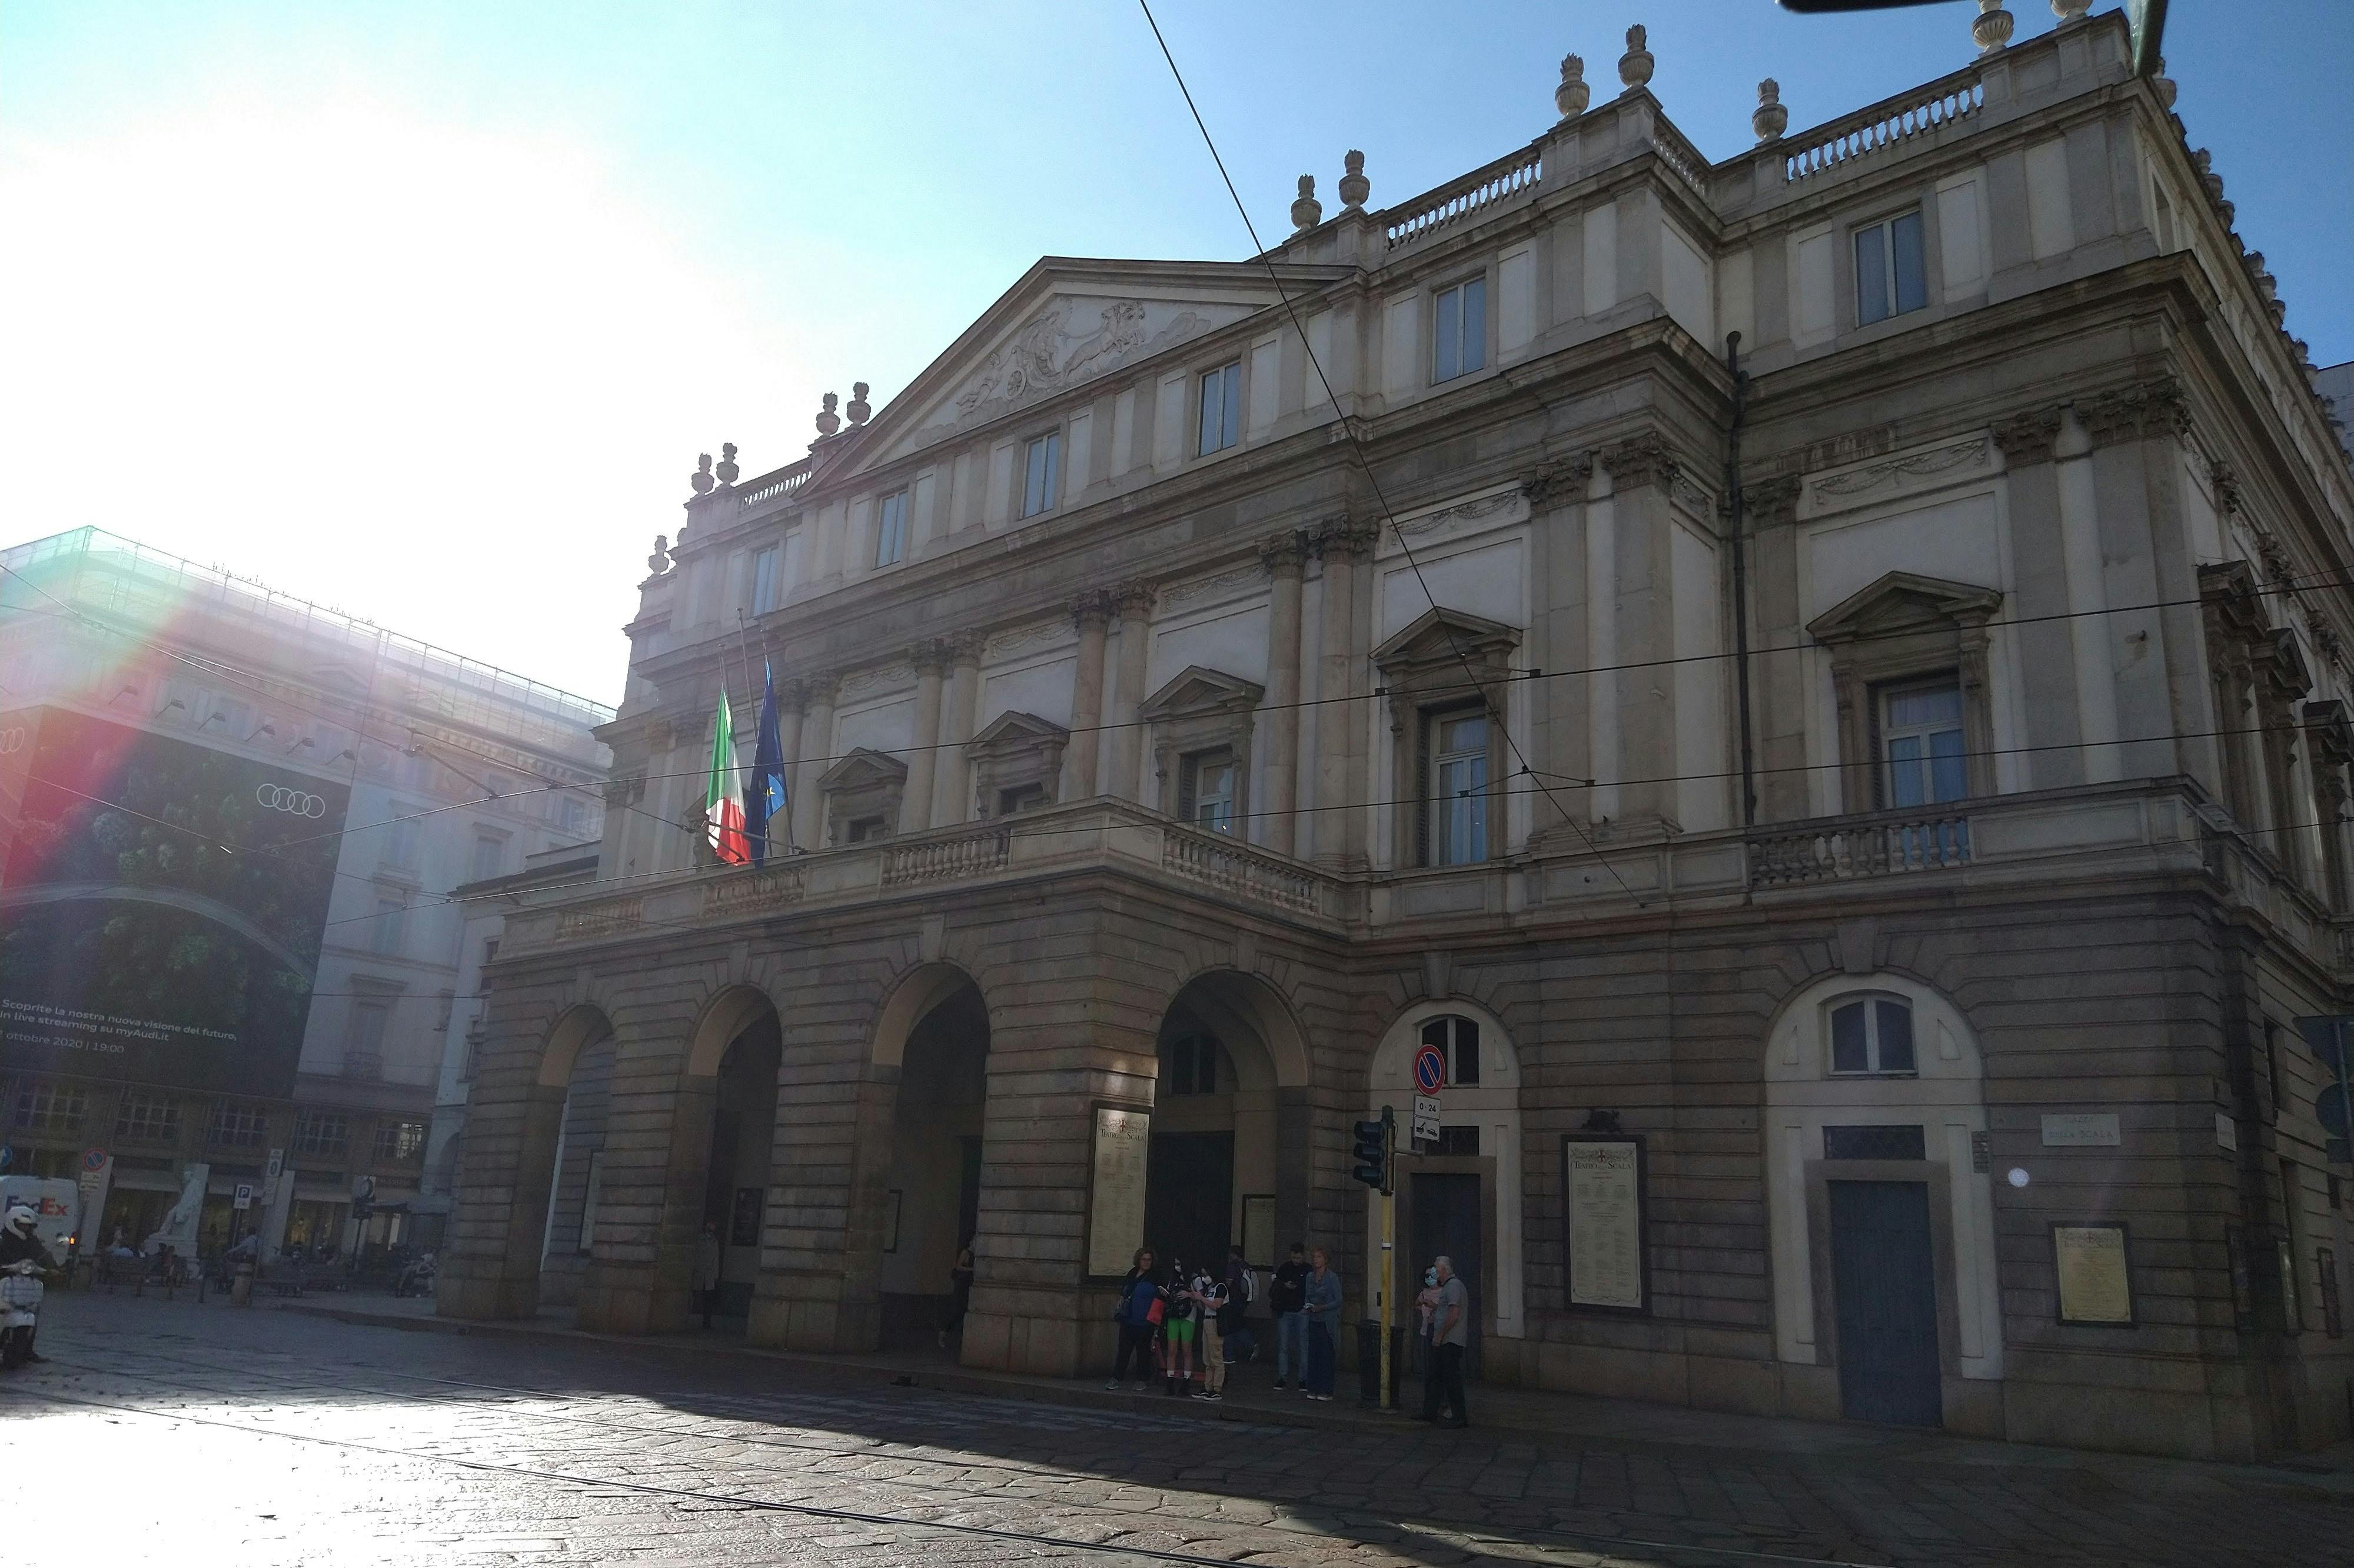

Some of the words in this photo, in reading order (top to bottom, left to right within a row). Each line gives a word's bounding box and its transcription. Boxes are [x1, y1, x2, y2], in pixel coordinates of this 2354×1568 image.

[2, 998, 52, 1013] Scoprite
[55, 1007, 65, 1016] la
[69, 1010, 105, 1021] nostra
[108, 1016, 141, 1026] nuova
[144, 1020, 181, 1032] visione
[184, 1026, 200, 1035] del
[203, 1028, 237, 1041] futuro,
[14, 1011, 35, 1023] live
[38, 1017, 97, 1033] streaming
[99, 1025, 113, 1034] su
[116, 1027, 169, 1041] myAudi.it
[6, 1032, 50, 1044] ottobre
[53, 1037, 83, 1048] 2020
[93, 1043, 125, 1053] 19:00
[1608, 1161, 1631, 1169] SCALA
